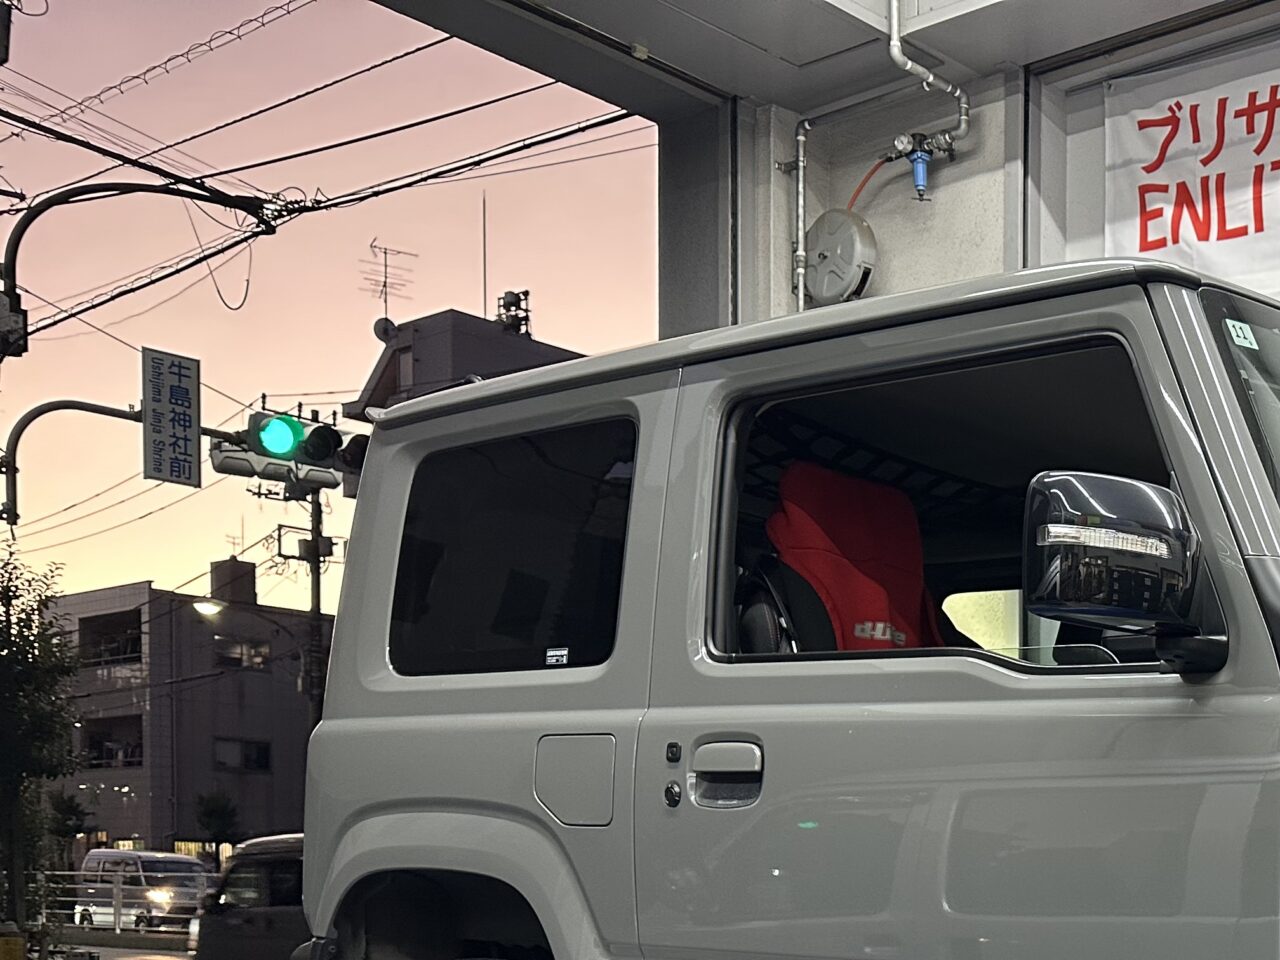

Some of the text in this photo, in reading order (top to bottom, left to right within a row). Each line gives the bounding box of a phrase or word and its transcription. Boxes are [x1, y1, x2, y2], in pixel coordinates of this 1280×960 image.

[149, 355, 166, 474] Ushijima Jinja Shrine
[167, 360, 192, 480] 牛島神社前
